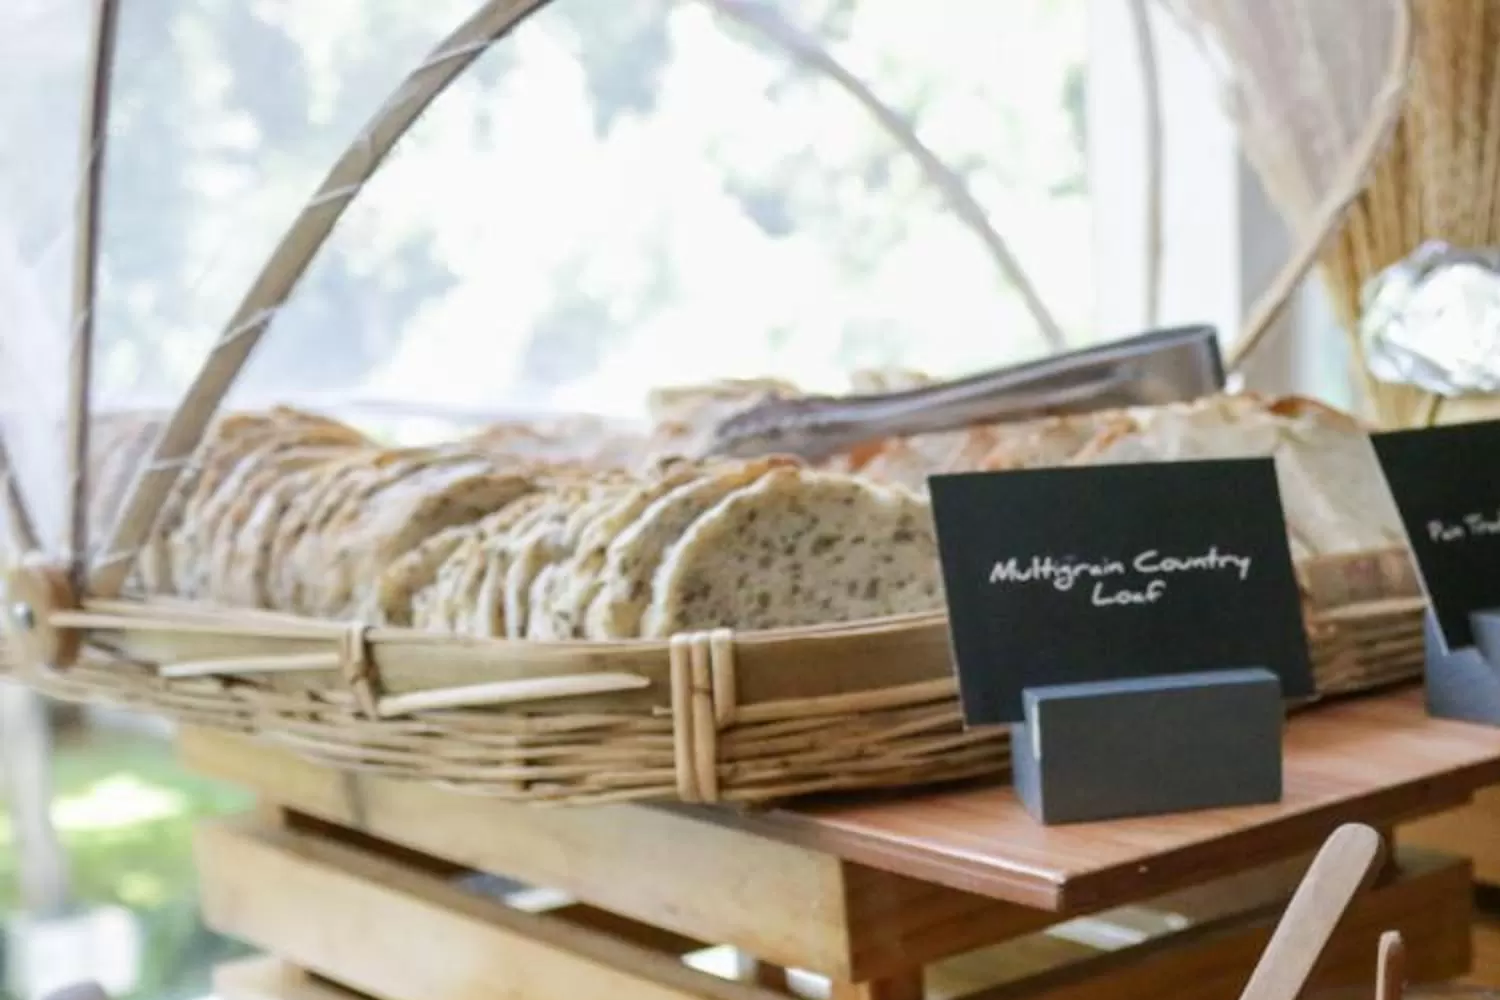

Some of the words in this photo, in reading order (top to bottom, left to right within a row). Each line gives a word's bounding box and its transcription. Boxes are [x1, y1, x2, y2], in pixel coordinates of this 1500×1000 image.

[989, 556, 1126, 591] Multigrain
[1132, 546, 1251, 581] Country
[1091, 579, 1167, 607] Loaf
